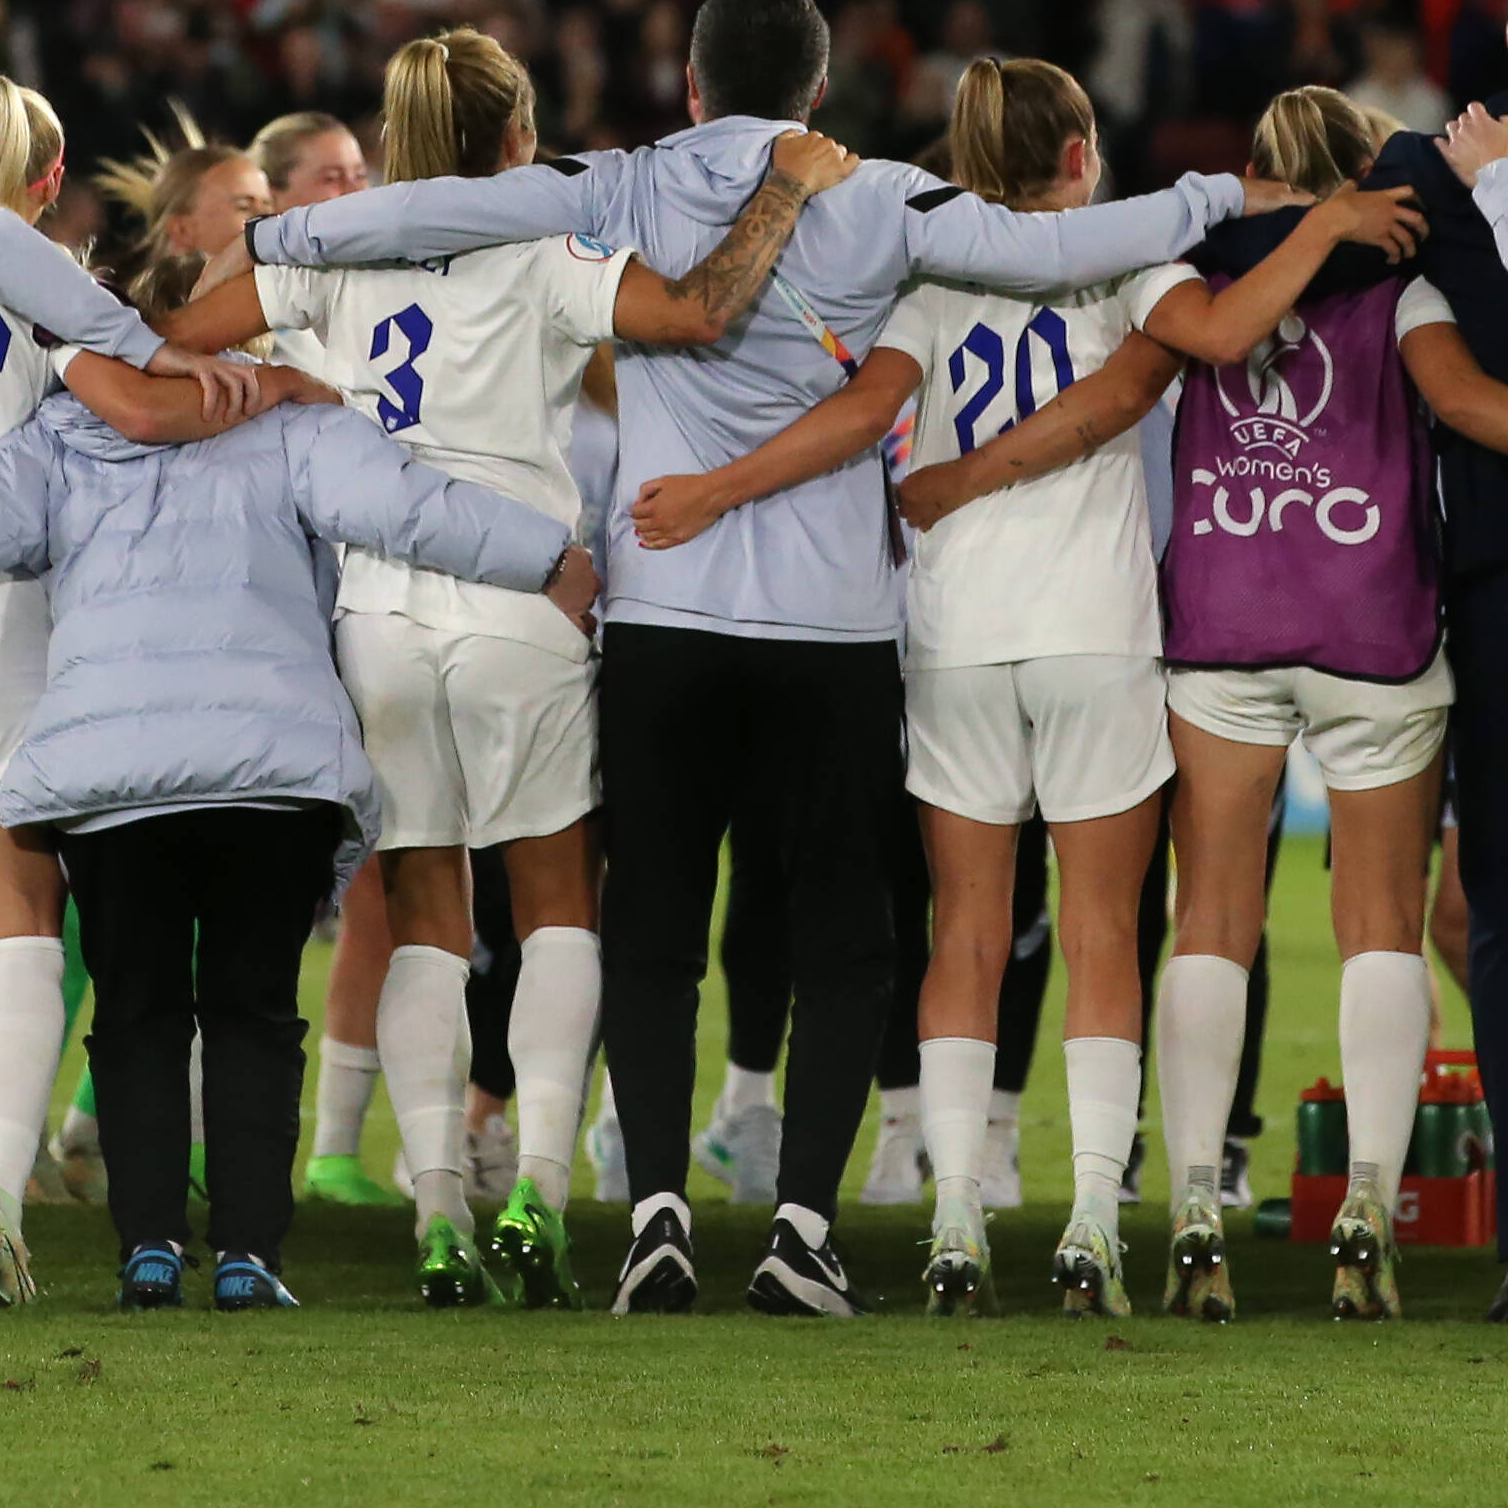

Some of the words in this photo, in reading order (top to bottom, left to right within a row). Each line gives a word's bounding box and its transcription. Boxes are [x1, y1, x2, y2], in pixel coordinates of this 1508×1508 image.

[369, 302, 434, 434] 3
[948, 305, 1076, 458] 20
[1233, 422, 1302, 458] UEFA
[1394, 1191, 1420, 1223] G
[133, 1262, 175, 1285] NIKE
[216, 1275, 255, 1298] NIKE
